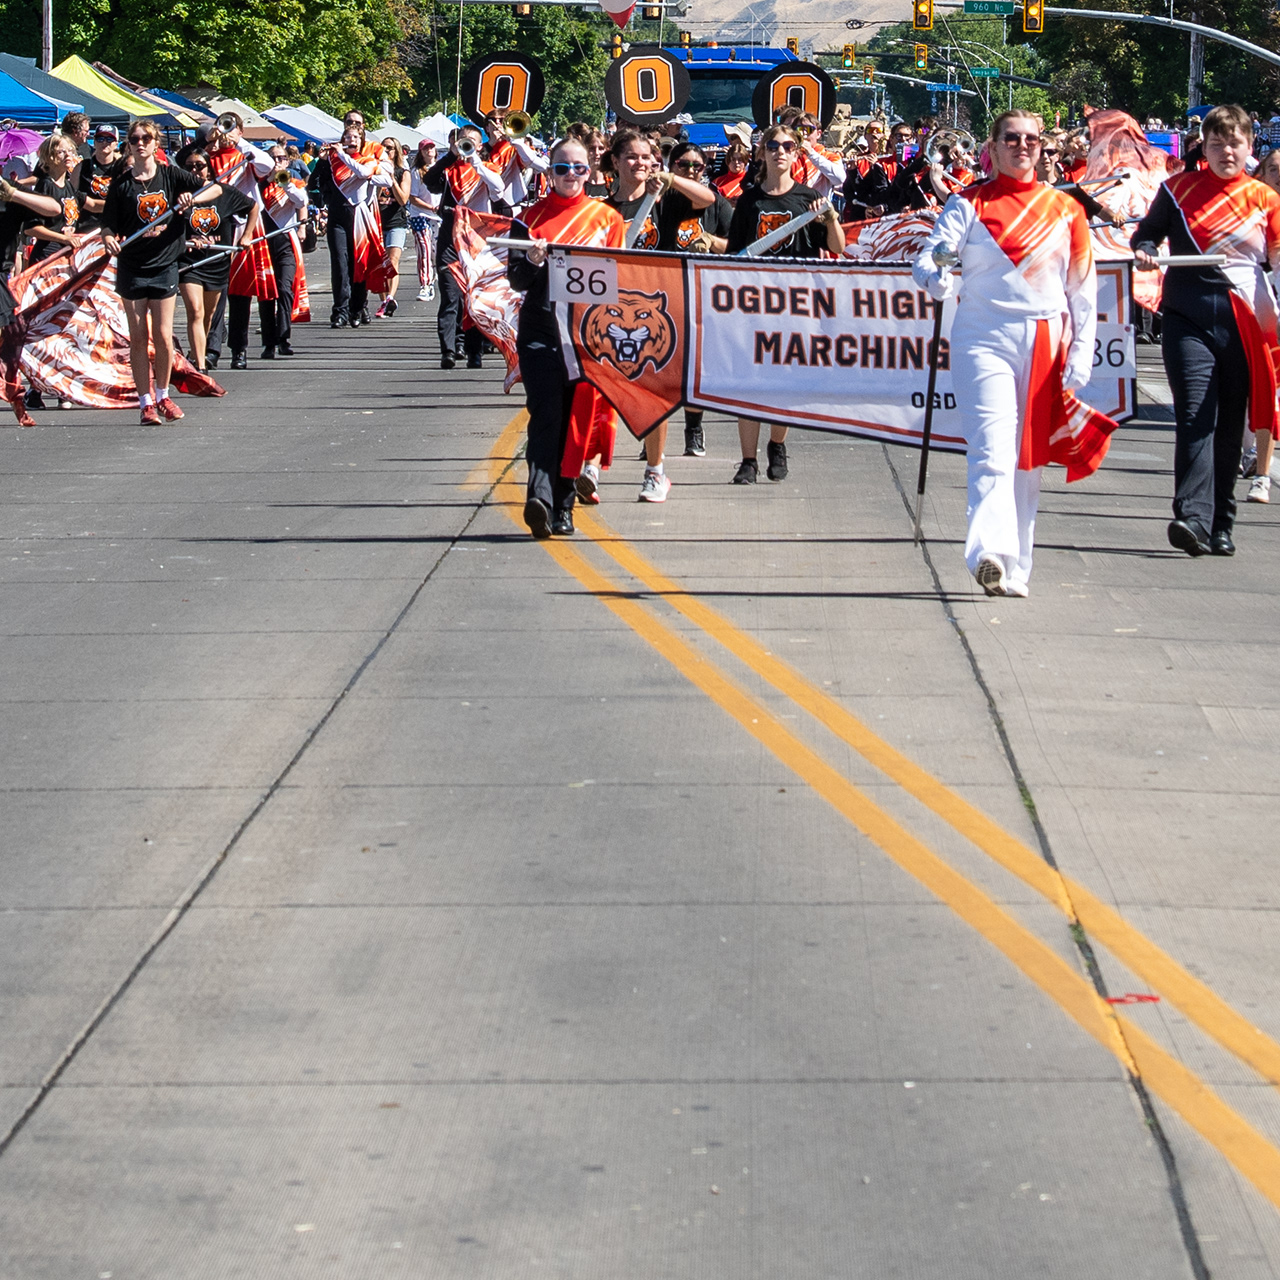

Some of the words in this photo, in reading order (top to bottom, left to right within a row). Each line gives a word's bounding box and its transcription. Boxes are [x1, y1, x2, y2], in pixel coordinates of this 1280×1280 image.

[973, 3, 989, 11] 960
[620, 55, 675, 115] O
[566, 267, 607, 296] 86
[711, 283, 837, 319] OGDEN
[754, 330, 951, 371] MARCHING
